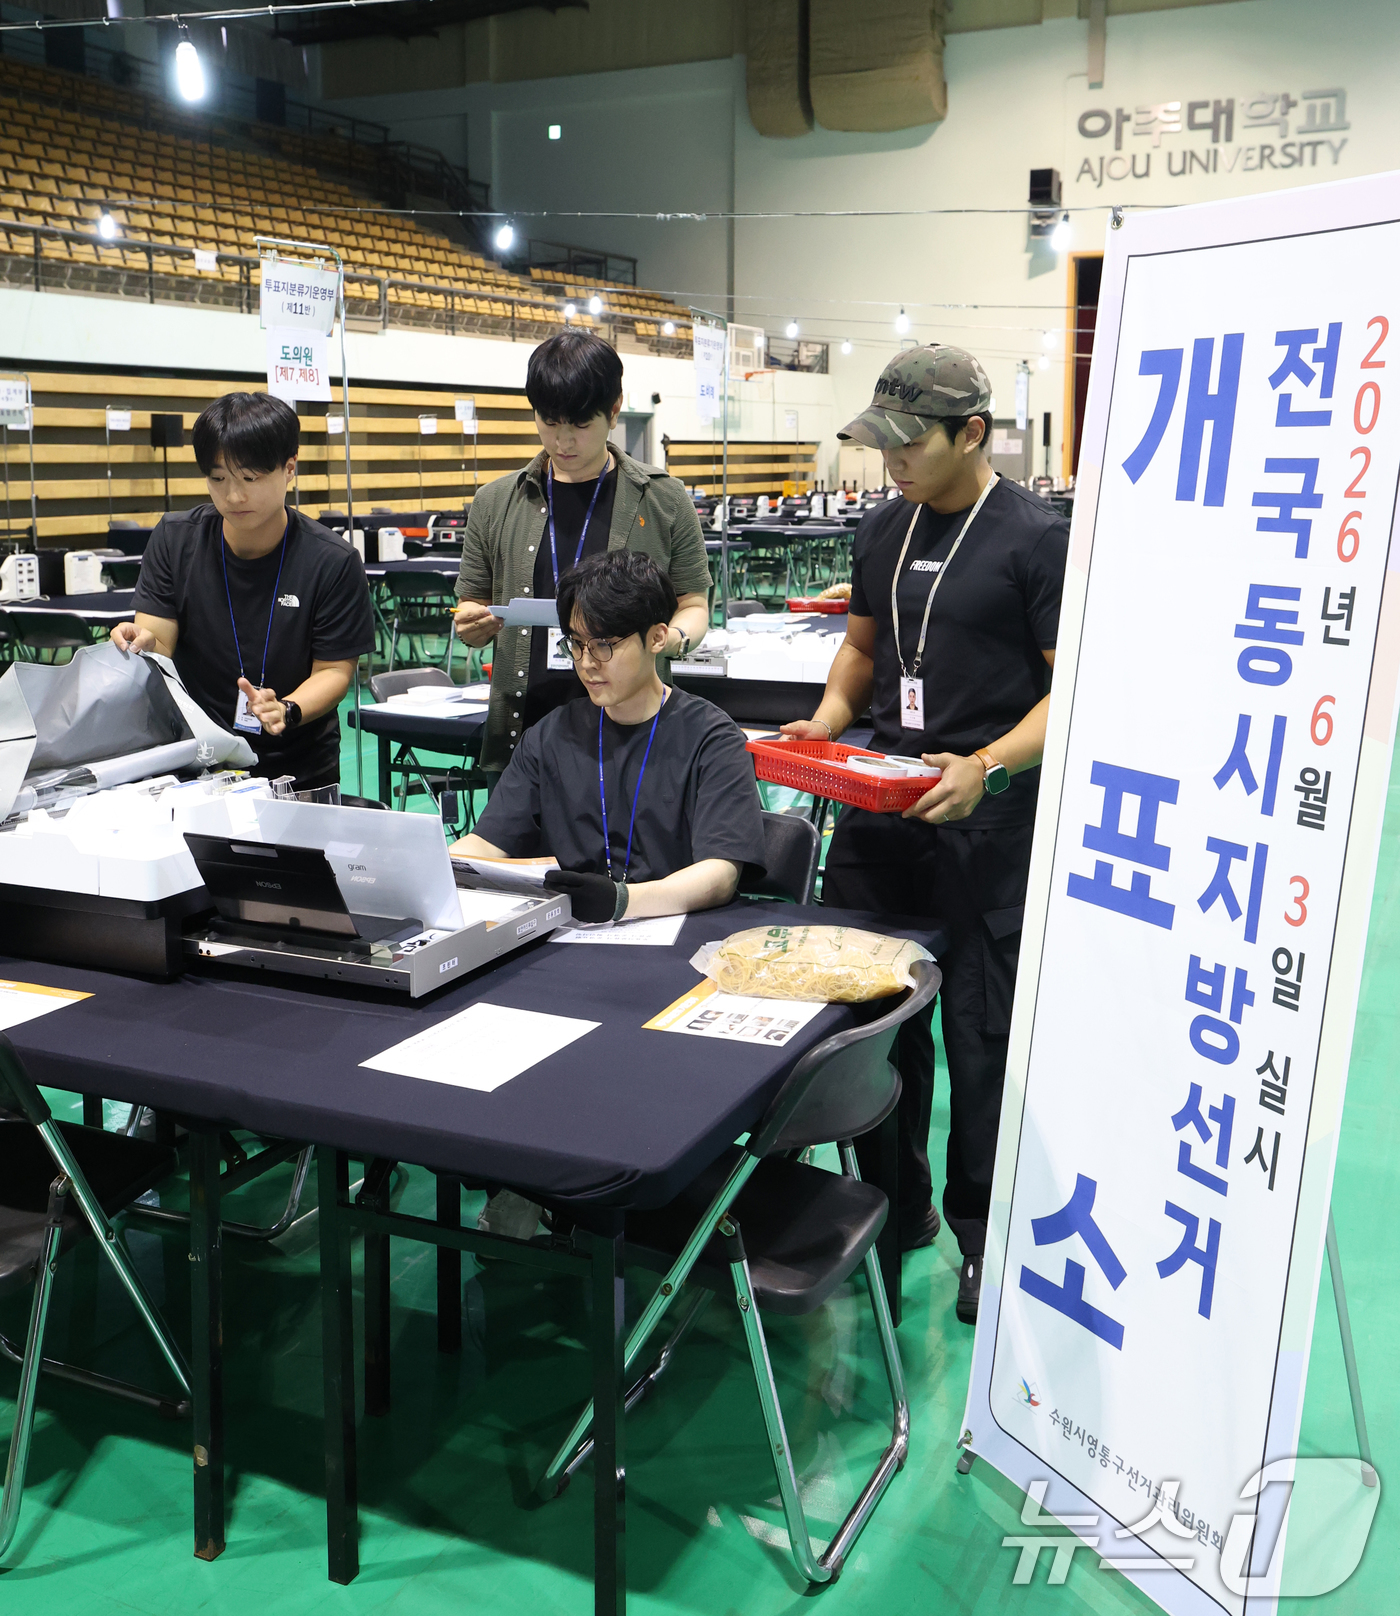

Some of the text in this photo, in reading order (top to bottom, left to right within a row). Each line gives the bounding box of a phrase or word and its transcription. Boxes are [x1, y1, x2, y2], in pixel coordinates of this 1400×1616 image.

[1077, 87, 1351, 151] 아주대학교
[1076, 138, 1349, 188] AJOU UNIVERSITY
[264, 279, 334, 302] 투표지분류기운영부
[280, 345, 313, 367] 도의원
[909, 559, 943, 573] FREEDOM
[347, 863, 367, 872] gram
[255, 880, 282, 890] EPSON
[1243, 1049, 1292, 1192] 실시
